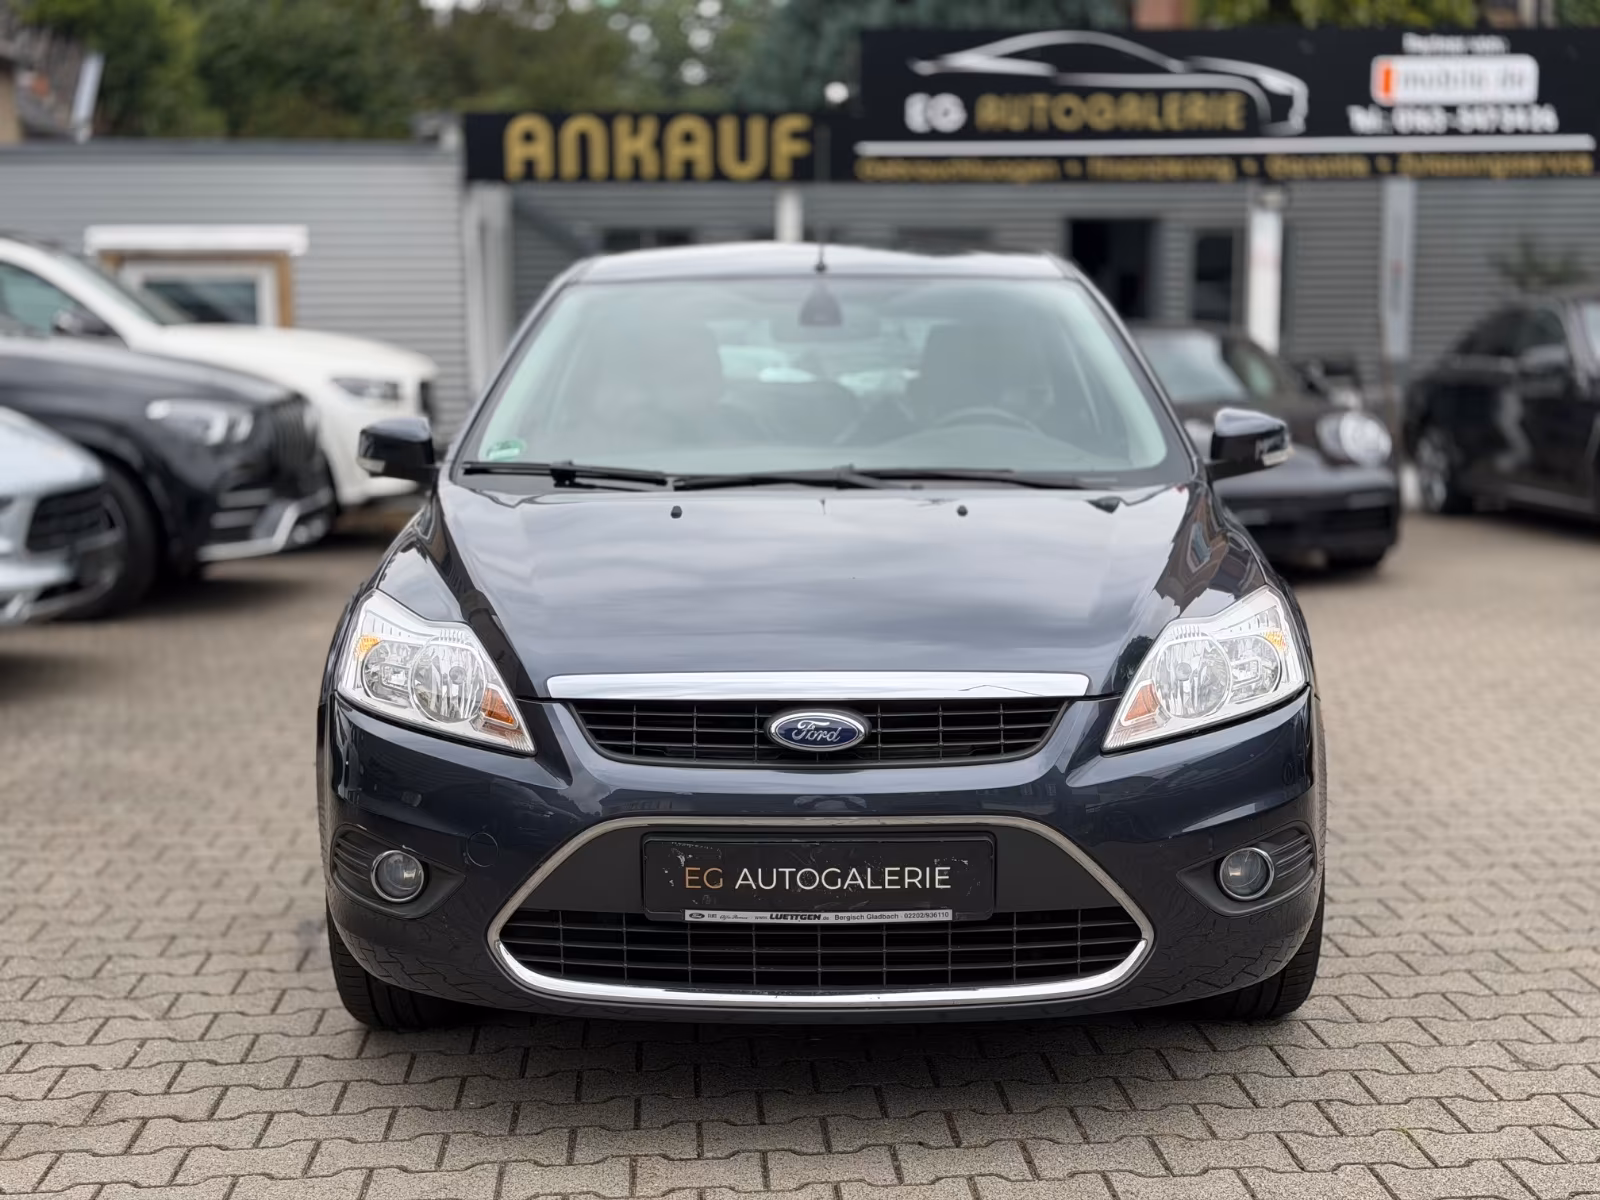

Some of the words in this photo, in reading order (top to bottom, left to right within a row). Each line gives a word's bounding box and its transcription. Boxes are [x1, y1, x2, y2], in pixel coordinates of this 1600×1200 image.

[974, 91, 1246, 133] AUTOGALERIE
[504, 112, 813, 181] ANKAUF
[791, 720, 842, 742] Ford
[685, 867, 723, 888] EG
[735, 866, 951, 890] AUTOGALERIE
[834, 913, 865, 922] Bergisch
